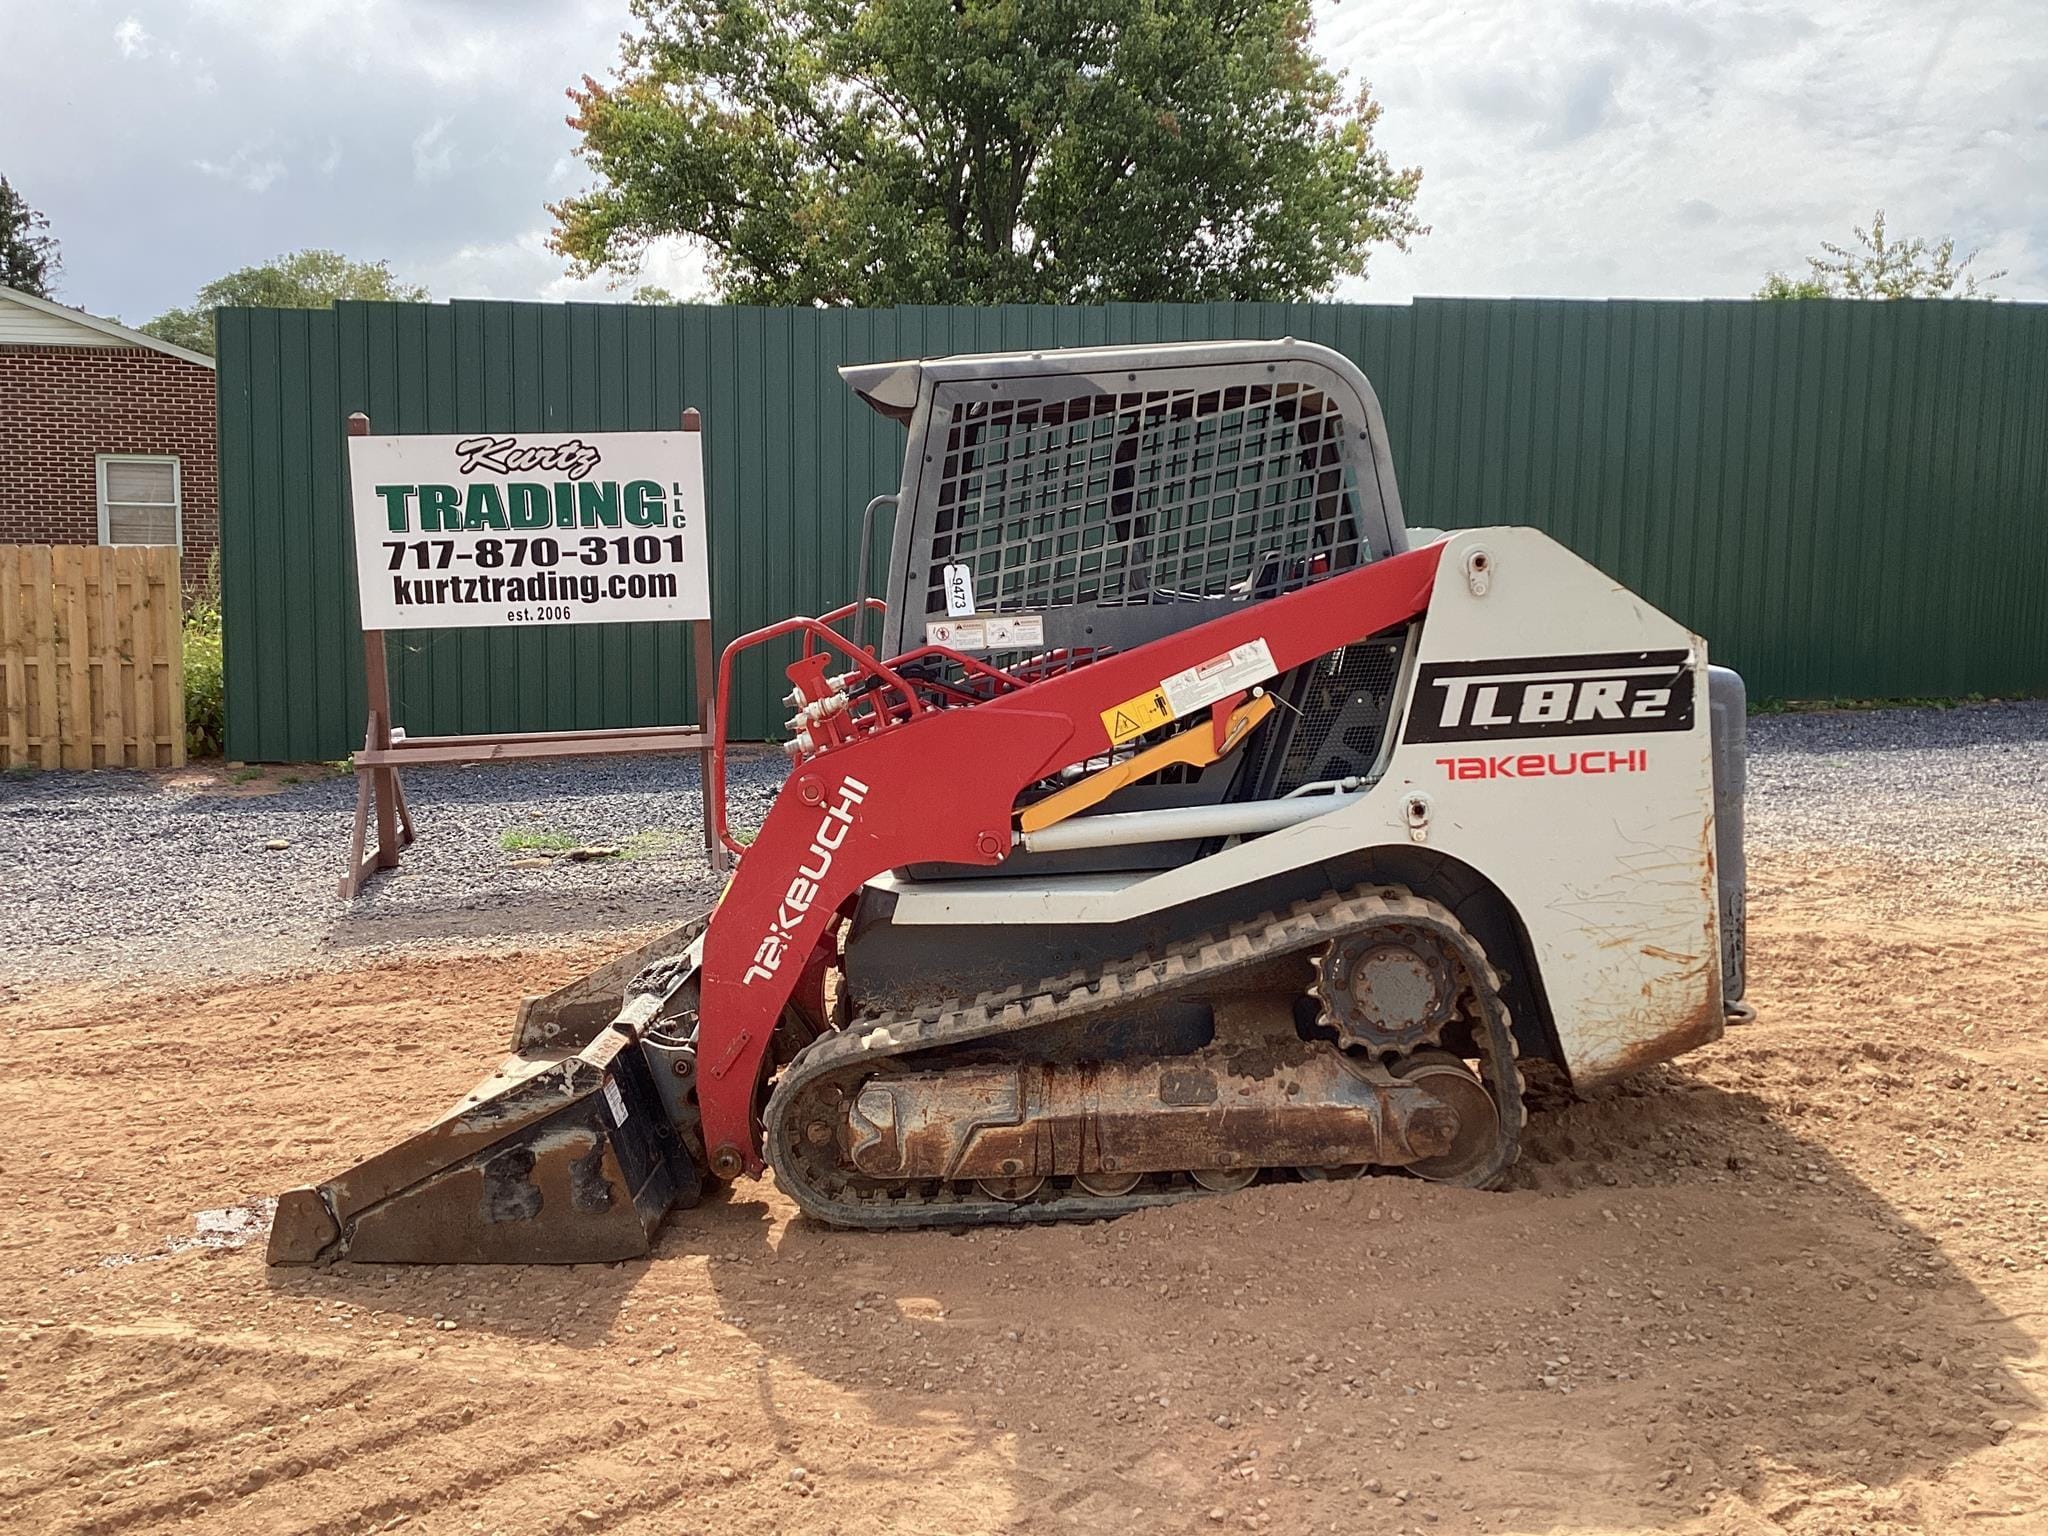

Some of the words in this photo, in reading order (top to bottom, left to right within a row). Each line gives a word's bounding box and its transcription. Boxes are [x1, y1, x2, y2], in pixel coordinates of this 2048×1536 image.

[455, 437, 600, 480] Kurtz
[375, 480, 668, 533] TRADING
[673, 482, 686, 529] LLC
[382, 535, 683, 571] 717-870-3101
[393, 571, 677, 605] kurtztrading.com
[952, 577, 966, 609] 9473
[507, 608, 534, 622] est.
[537, 606, 571, 621] 2006
[1432, 665, 1680, 728] TL8R2
